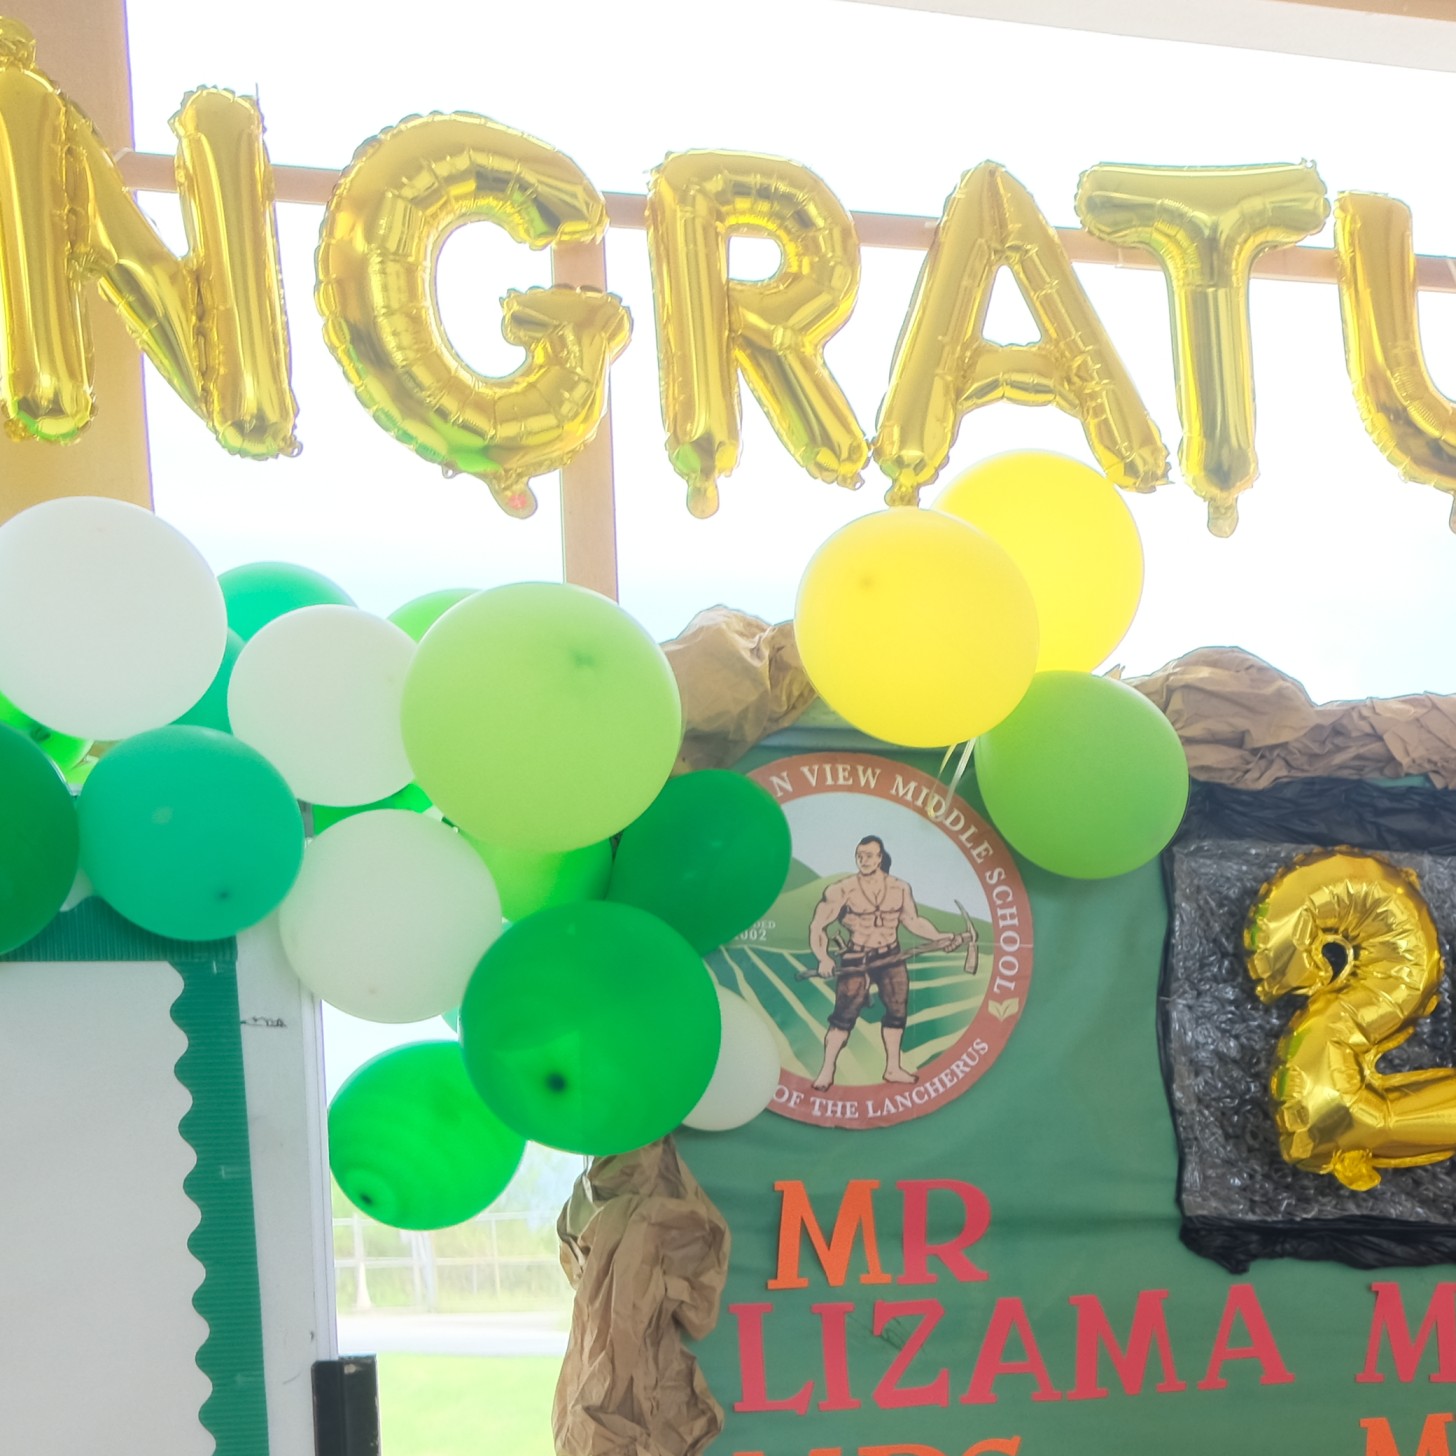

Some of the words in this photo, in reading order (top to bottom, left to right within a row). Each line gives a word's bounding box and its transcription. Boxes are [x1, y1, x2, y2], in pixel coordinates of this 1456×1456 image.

[800, 764, 882, 789] VIEW
[889, 774, 994, 864] MIDDLE
[984, 867, 1020, 994] SCHOOL
[772, 1084, 804, 1108] OF
[809, 1096, 859, 1118] THE
[866, 1038, 989, 1119] LANCHERUS
[767, 1178, 992, 1290] MR
[728, 1283, 1296, 1415] LIZAMA
